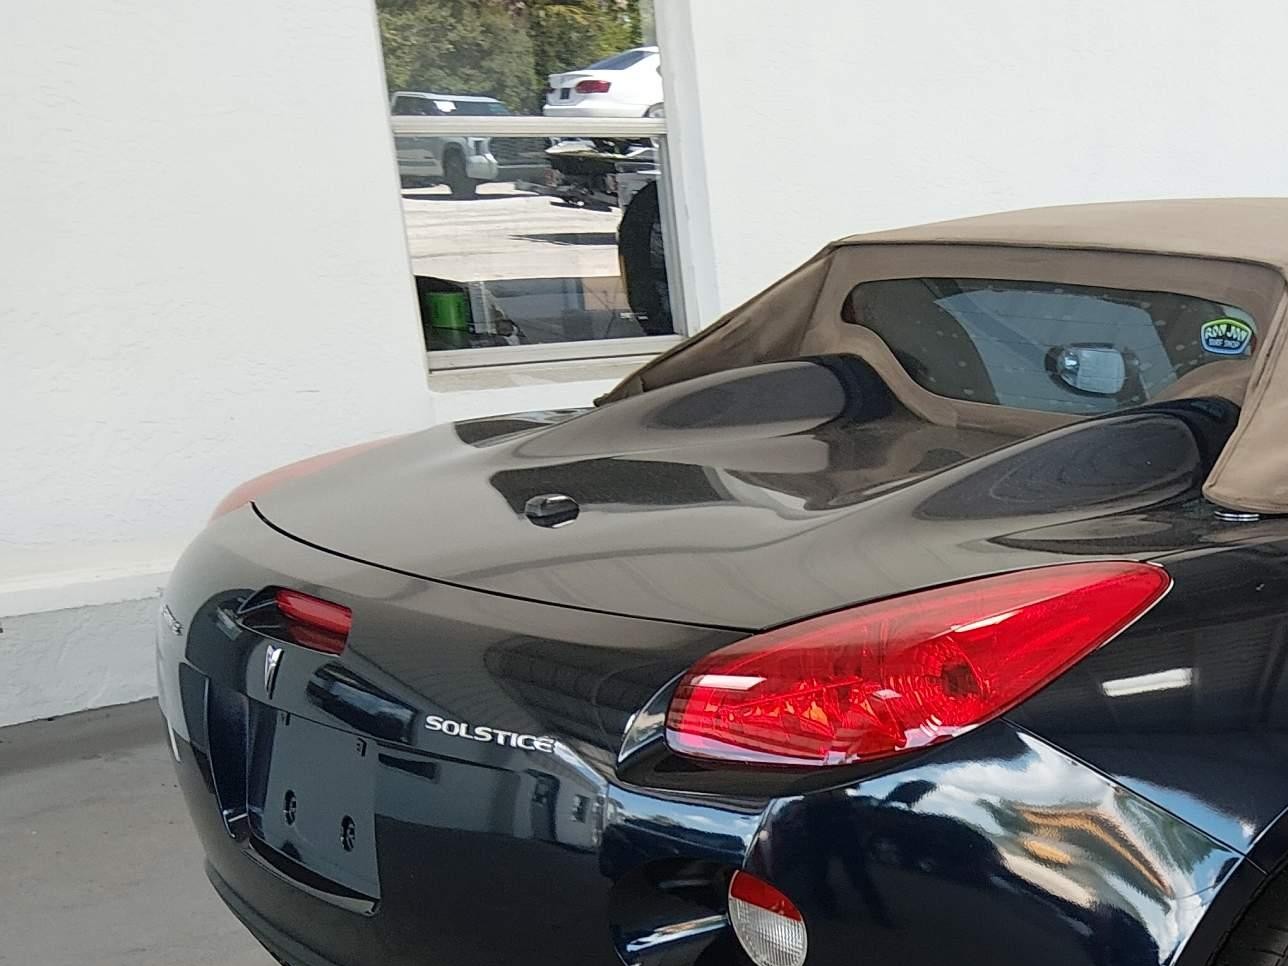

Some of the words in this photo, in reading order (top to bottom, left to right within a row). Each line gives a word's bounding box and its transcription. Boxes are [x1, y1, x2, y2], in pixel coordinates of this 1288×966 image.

[1205, 324, 1228, 339] RON
[1226, 325, 1248, 342] JON
[425, 715, 555, 753] SOLSTICE
